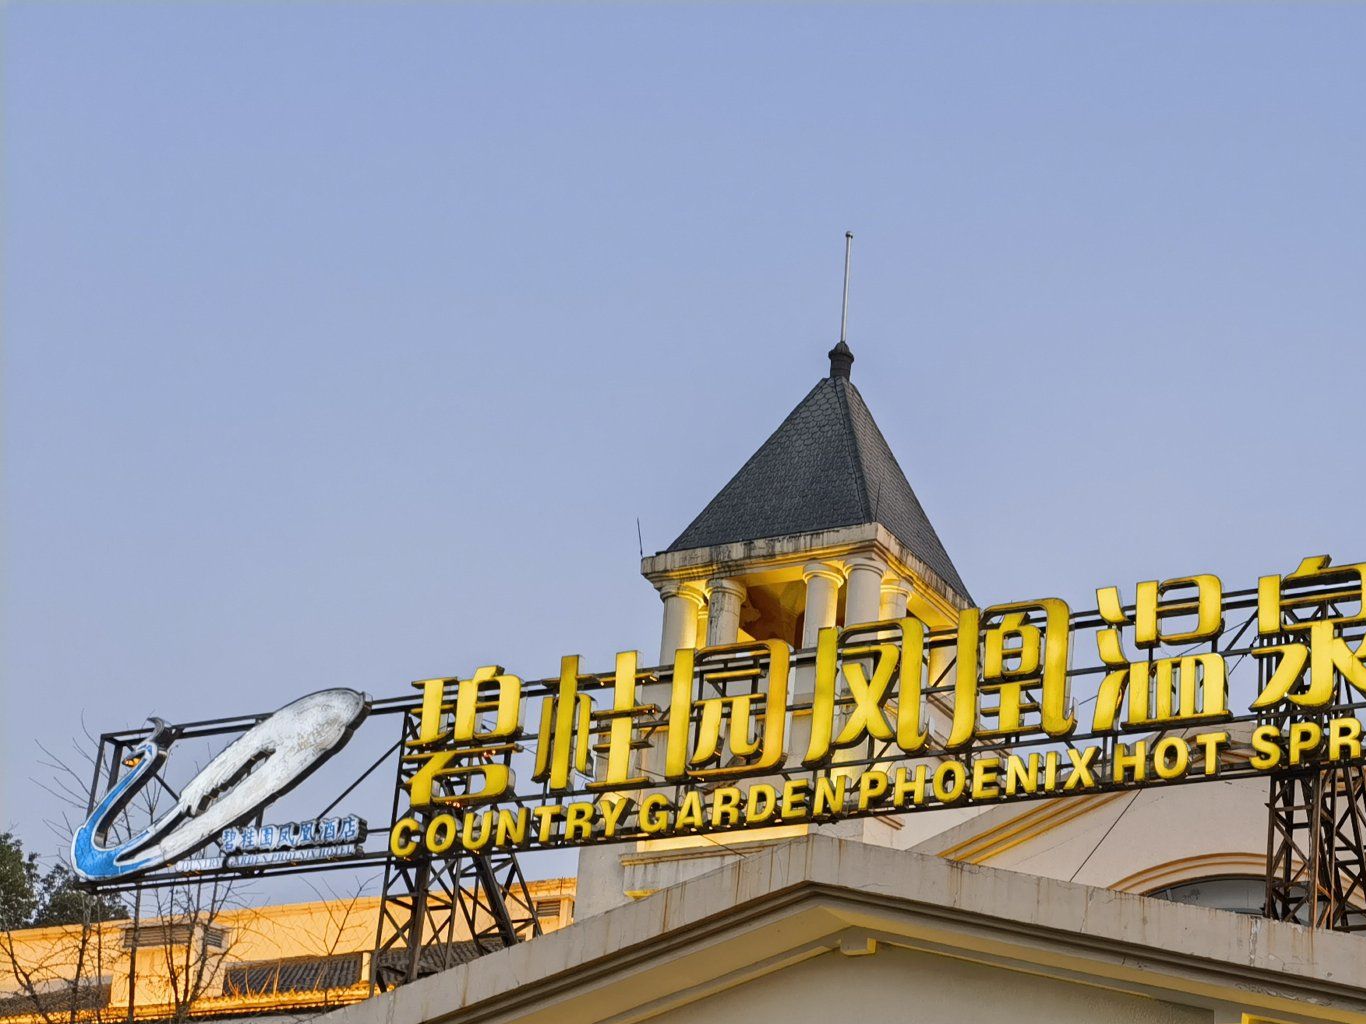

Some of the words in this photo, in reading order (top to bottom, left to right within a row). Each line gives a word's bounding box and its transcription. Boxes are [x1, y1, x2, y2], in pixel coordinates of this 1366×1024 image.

[389, 791, 632, 859] COUNTRY
[638, 774, 851, 834] GARDEN
[858, 746, 1102, 812] PHOENIX
[1112, 731, 1231, 785] HOT
